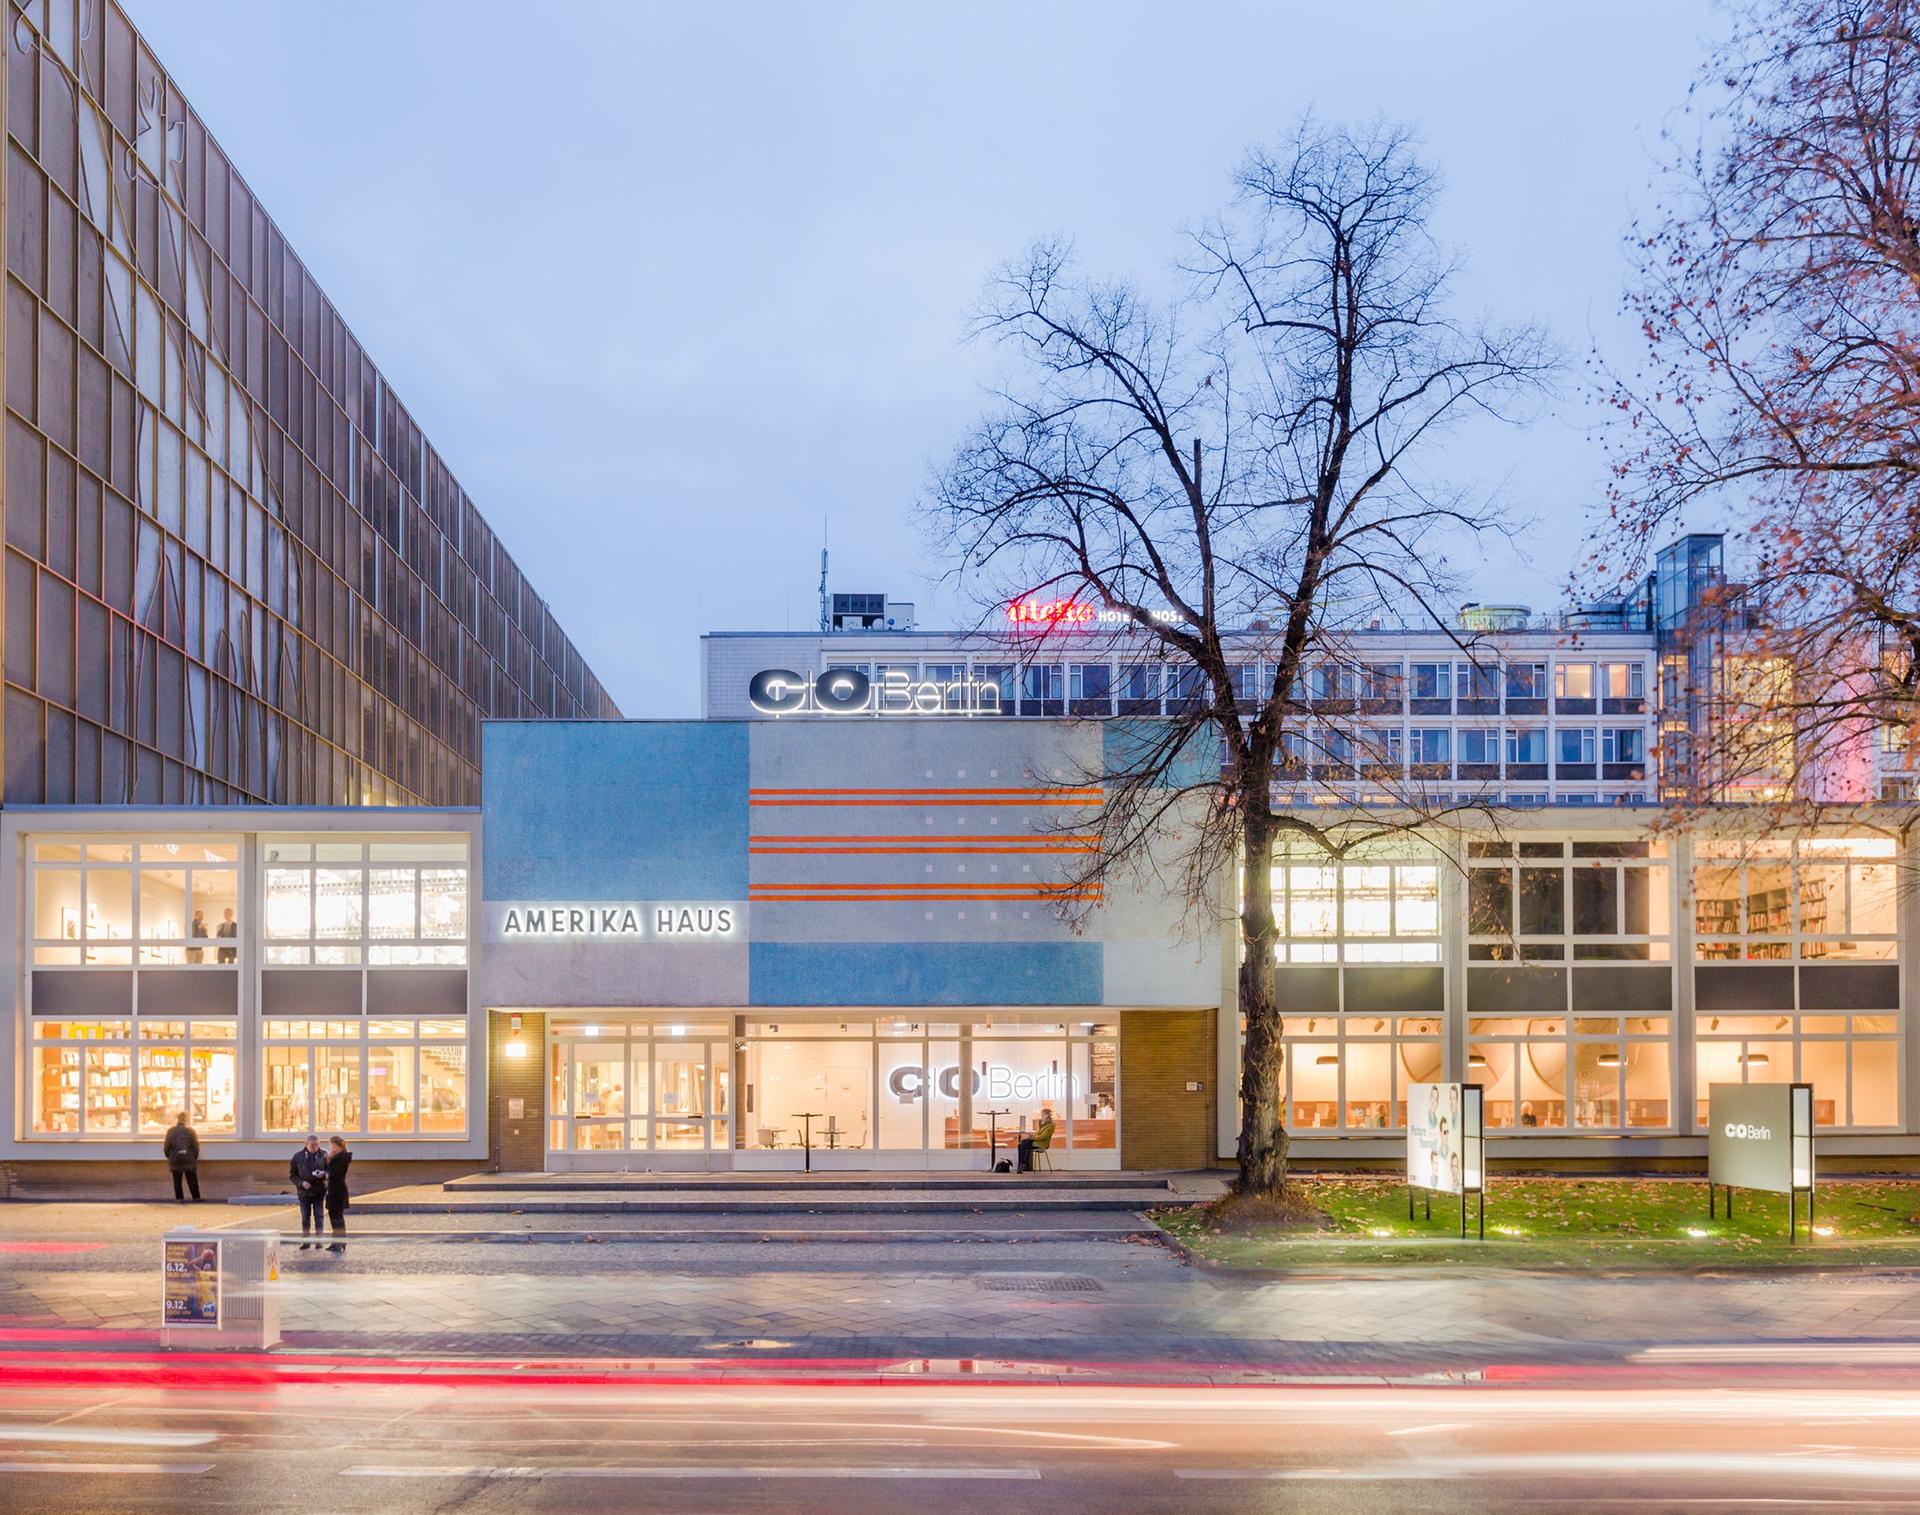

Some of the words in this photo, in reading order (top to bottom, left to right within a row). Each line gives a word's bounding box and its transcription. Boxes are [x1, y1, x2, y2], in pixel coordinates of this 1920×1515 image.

[1099, 611, 1138, 623] HOTE
[885, 671, 1001, 714] Berlin
[504, 909, 639, 933] AMERIKA
[657, 909, 731, 933] HAUS
[990, 1067, 1077, 1099] Berlin
[1747, 1124, 1771, 1140] Berlin
[166, 1263, 188, 1272] 6.12.
[166, 1300, 187, 1310] 9.12.
